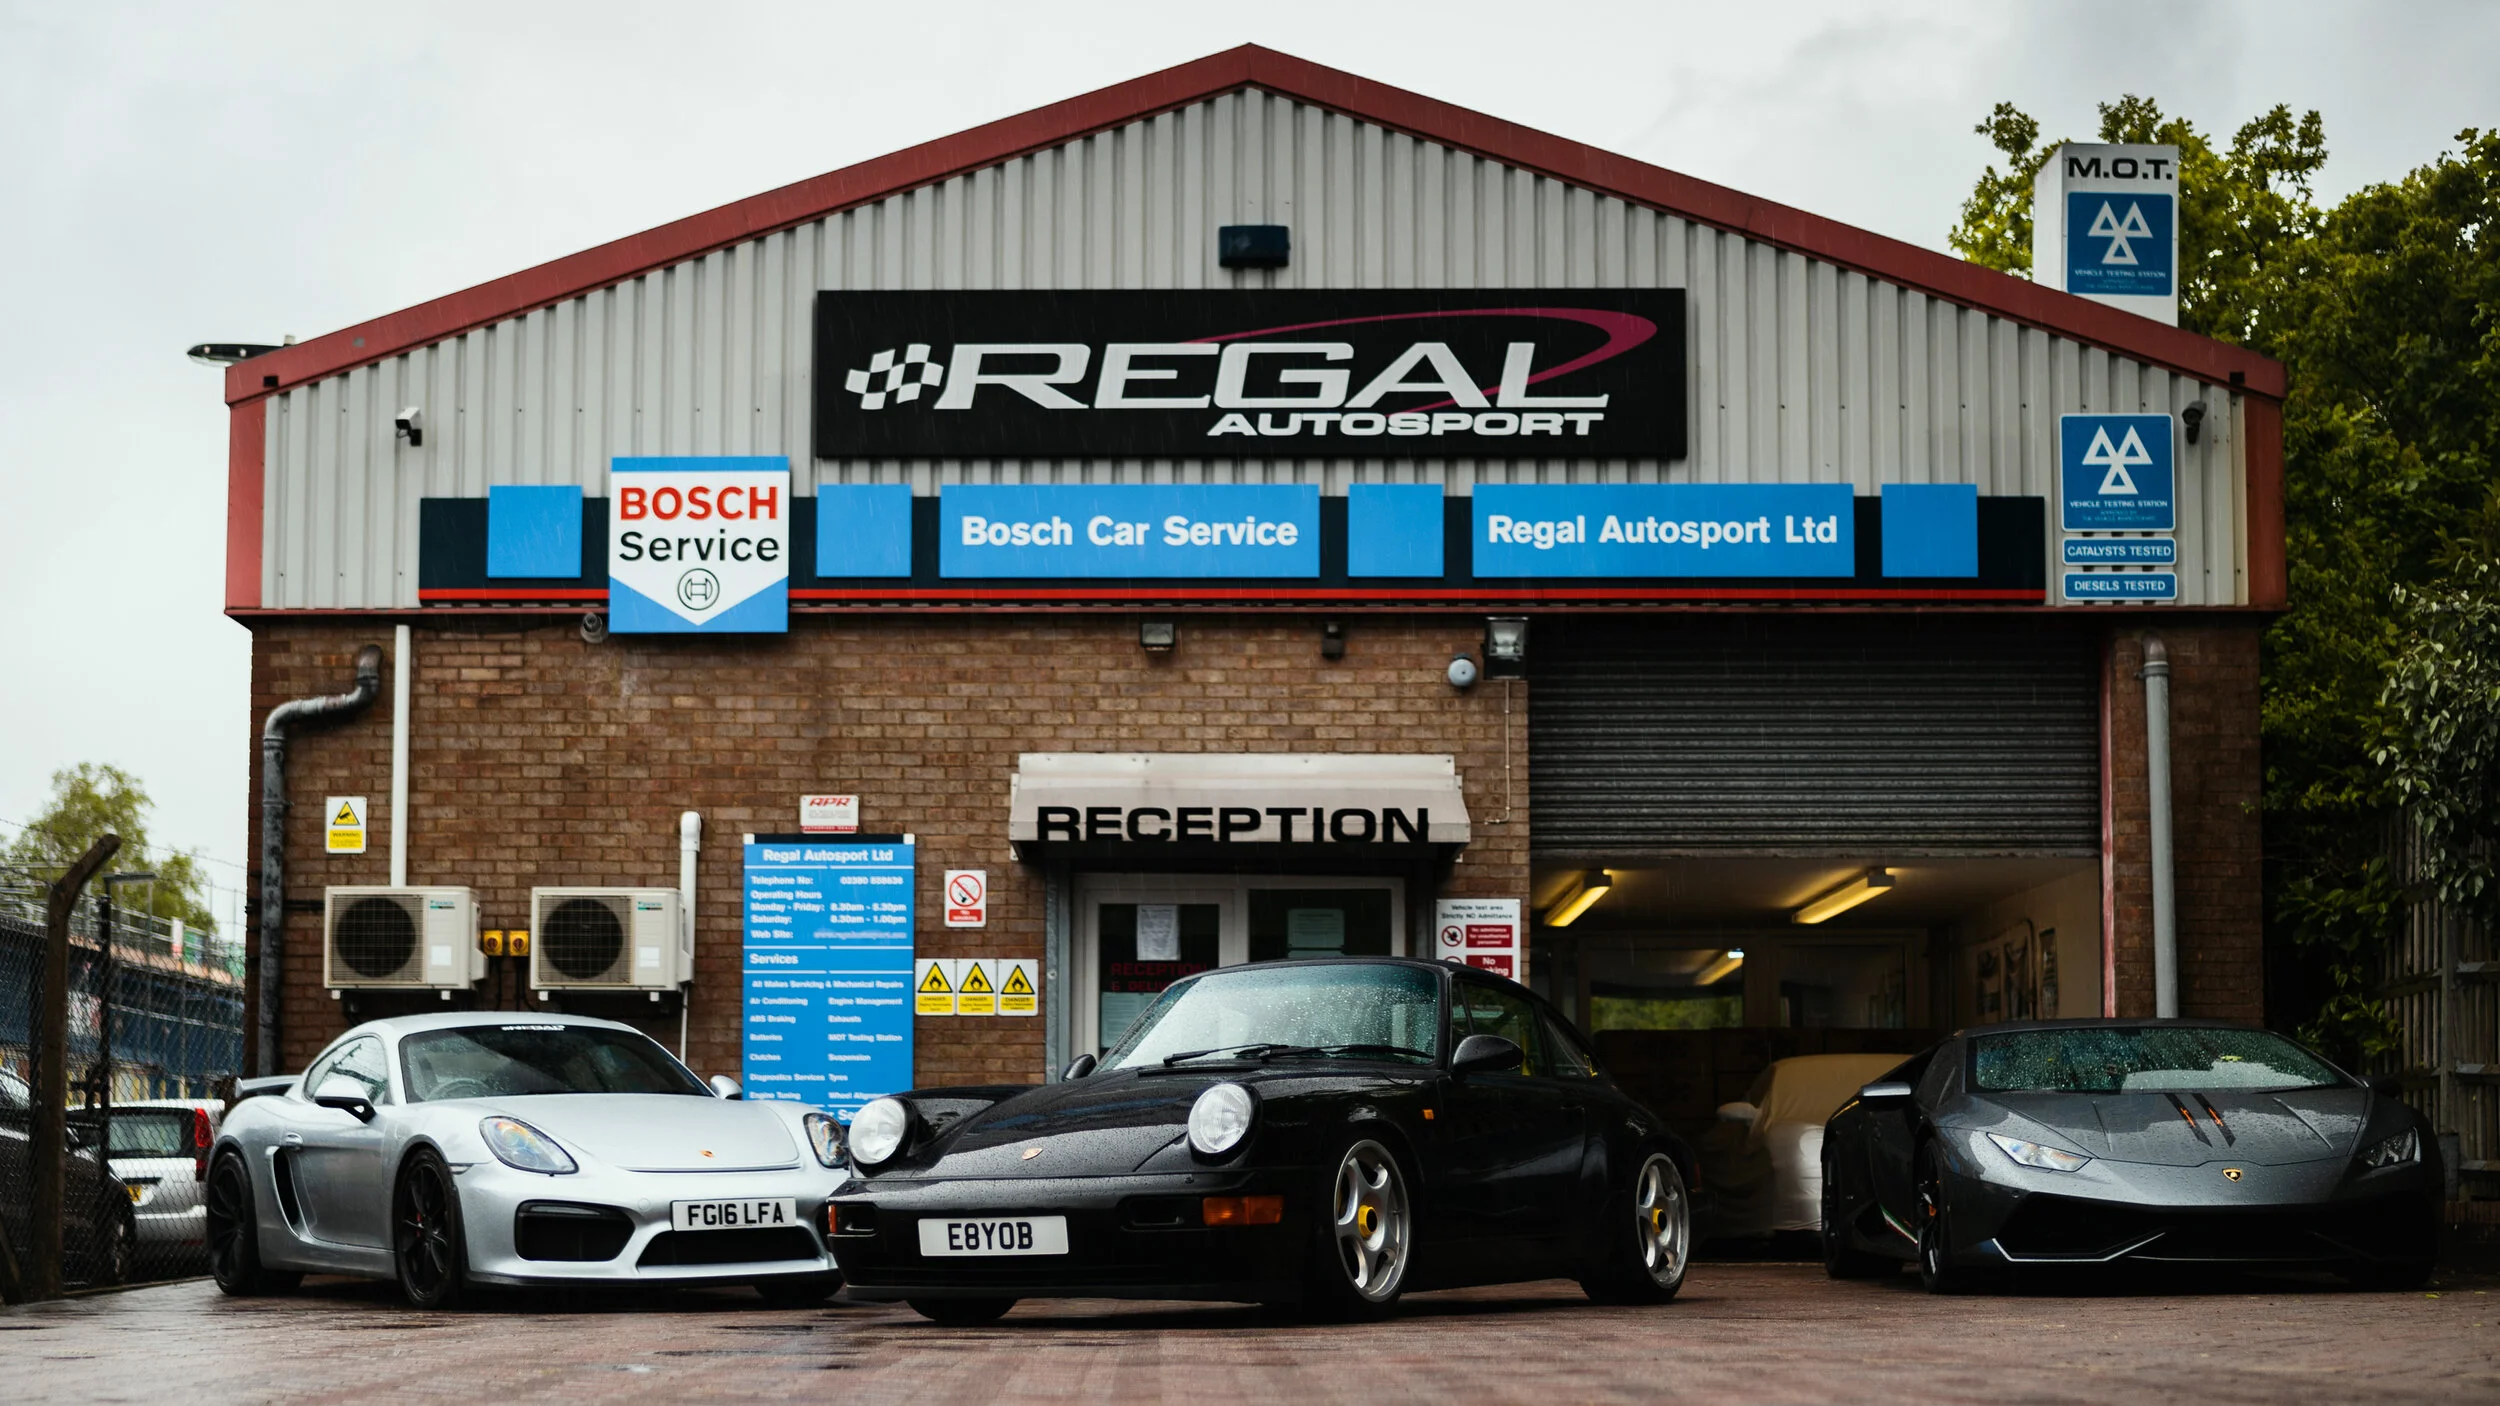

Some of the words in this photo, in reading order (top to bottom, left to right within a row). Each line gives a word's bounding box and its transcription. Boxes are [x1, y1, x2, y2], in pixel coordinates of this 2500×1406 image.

[2068, 157, 2173, 180] M.O.T.
[934, 341, 1609, 410] REGAL
[1207, 412, 1603, 437] AUTOSPORT
[620, 486, 778, 521] BOSCH
[2069, 500, 2101, 508] VEHICLE
[2104, 500, 2135, 508] TESTING
[2137, 500, 2168, 508] STATION
[961, 515, 1073, 546] Bosch
[1087, 515, 1150, 546] Car
[1163, 515, 1299, 546] Service
[1488, 515, 1586, 550] Regal
[1598, 515, 1771, 549] Autosport
[1785, 515, 1838, 544] Ltd
[619, 528, 780, 562] Service
[2067, 546, 2126, 557] CATALYSTS
[2130, 546, 2172, 557] TESTED
[2074, 581, 2120, 591] DIESELS
[2124, 581, 2166, 591] TESTED
[1037, 806, 1429, 843] RECEPTION
[763, 849, 801, 863] Regal
[804, 849, 868, 863] Autosport
[872, 849, 893, 861] Ltd
[751, 875, 795, 887] Telephone
[750, 889, 794, 901] Operating
[795, 889, 823, 899] Hours
[750, 902, 786, 913] Monday
[793, 902, 825, 913] Friday:
[750, 914, 793, 925] Saturday:
[750, 929, 771, 939] Web
[749, 953, 799, 965] Services
[1482, 956, 1496, 965] No
[752, 980, 763, 988] All
[789, 980, 825, 989] Servicing
[832, 980, 875, 988] Mechanical
[875, 980, 905, 989] Repairs
[761, 997, 808, 1006] Conditioning
[828, 997, 854, 1006] Engine
[855, 997, 903, 1006] Management
[767, 1015, 796, 1024] Braking
[828, 1015, 862, 1023] Exhausts
[749, 1033, 783, 1041] Batteries
[848, 1034, 875, 1042] Testing
[749, 1053, 782, 1061] Clutches
[828, 1053, 871, 1062] Suspension
[749, 1073, 792, 1082] Diagnostics
[793, 1073, 825, 1081] Services
[828, 1073, 848, 1082] Tyres
[749, 1091, 775, 1099] Engine
[776, 1091, 801, 1099] Tuning
[828, 1091, 852, 1099] Wheel
[687, 1203, 738, 1226] FG16
[744, 1202, 784, 1224] LFA
[947, 1221, 1033, 1251] E8YOB
